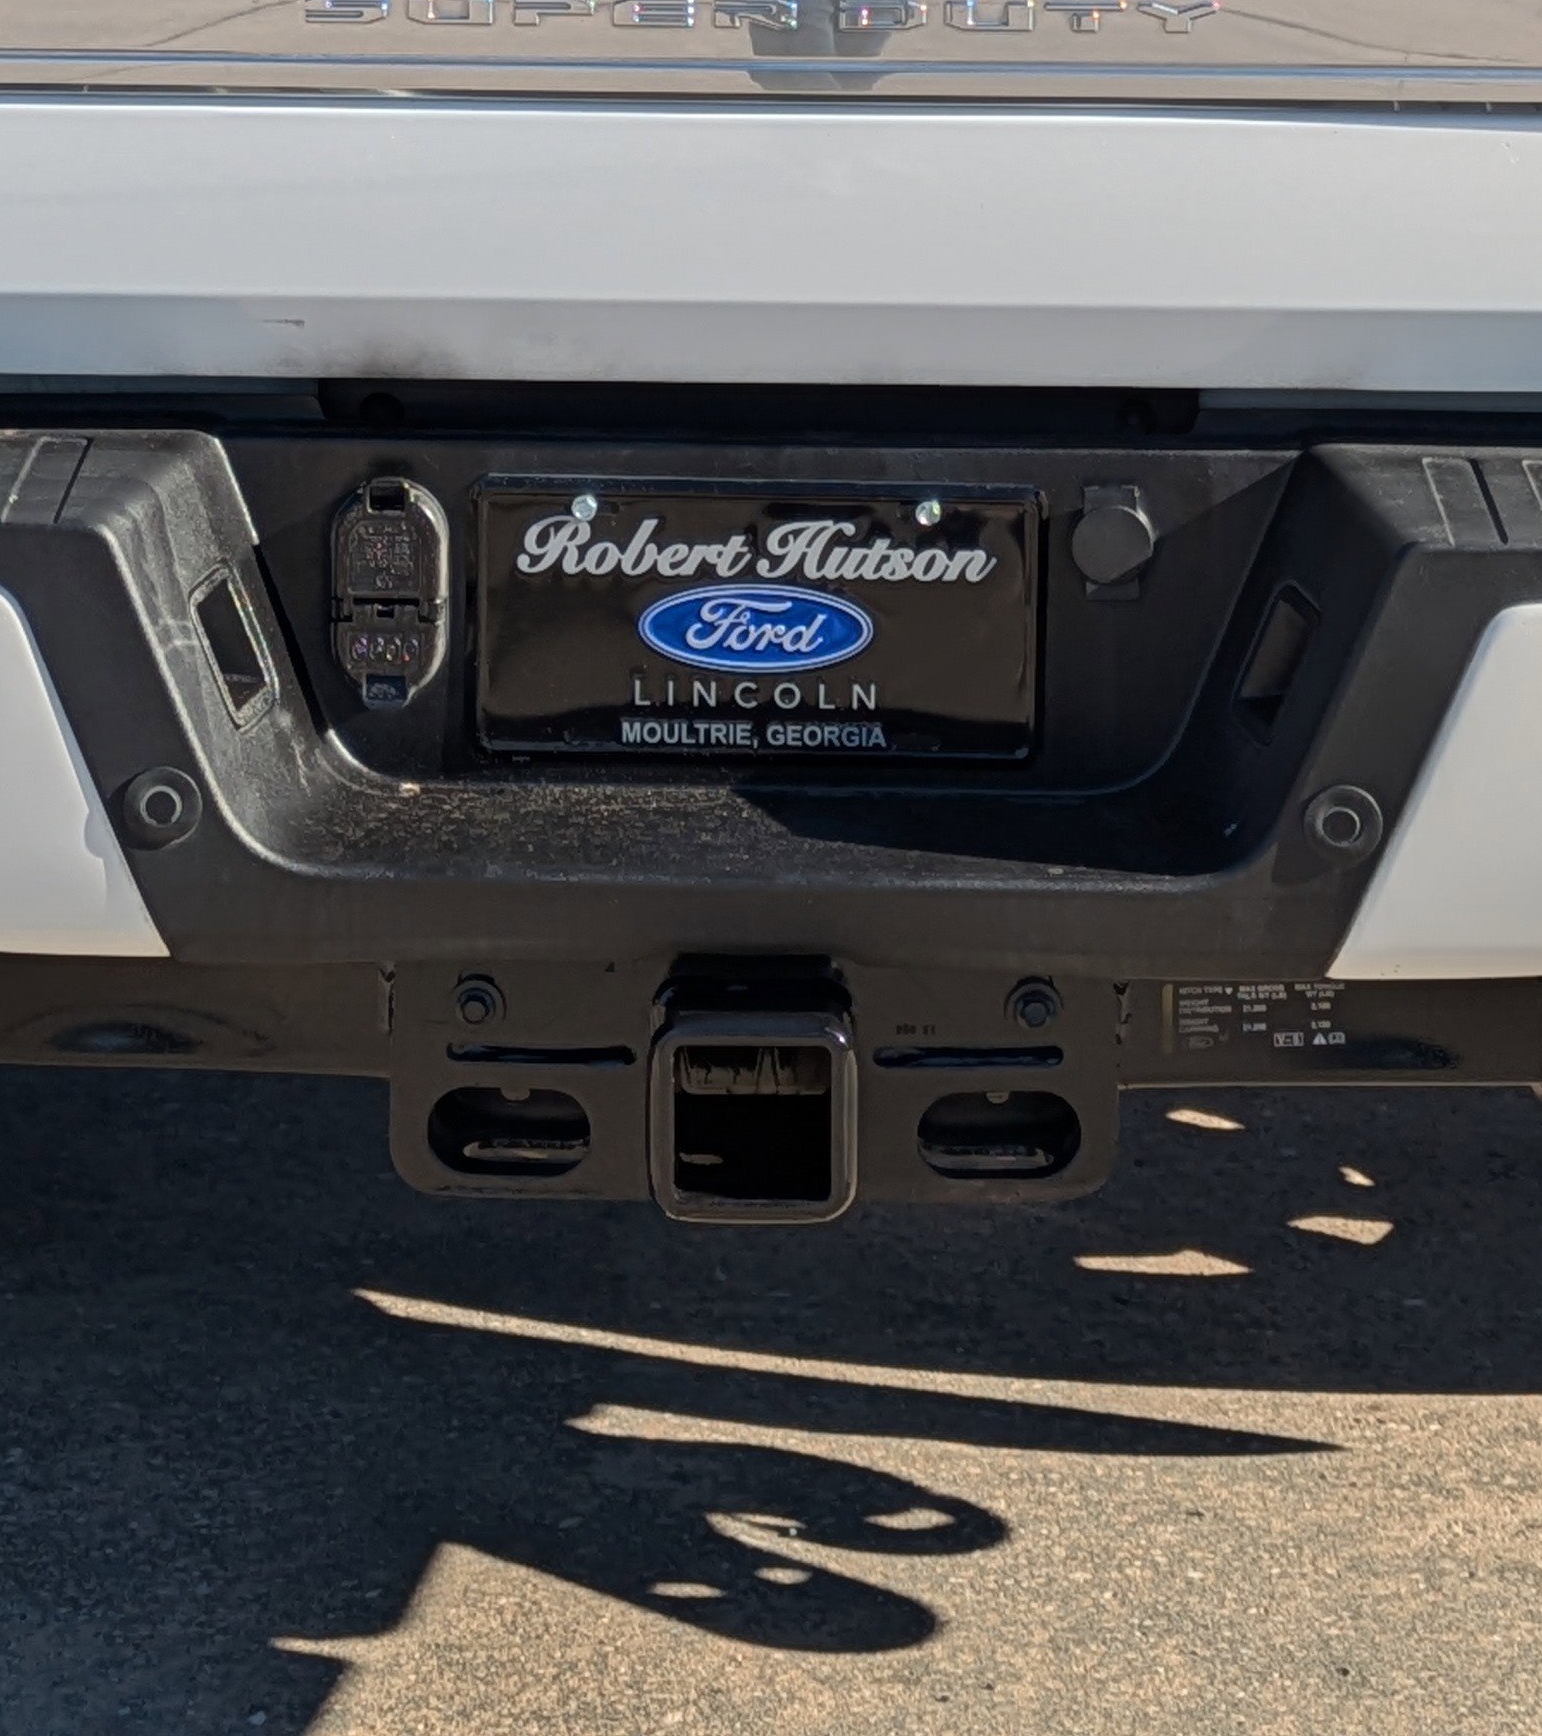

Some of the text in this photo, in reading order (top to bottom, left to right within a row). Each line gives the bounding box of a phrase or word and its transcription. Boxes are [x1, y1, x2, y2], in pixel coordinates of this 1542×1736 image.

[516, 514, 997, 583] Robert Hutson
[685, 597, 827, 654] Ford
[633, 679, 877, 711] LINCOLN
[621, 721, 887, 749] MOULTRIE, GEORGIA
